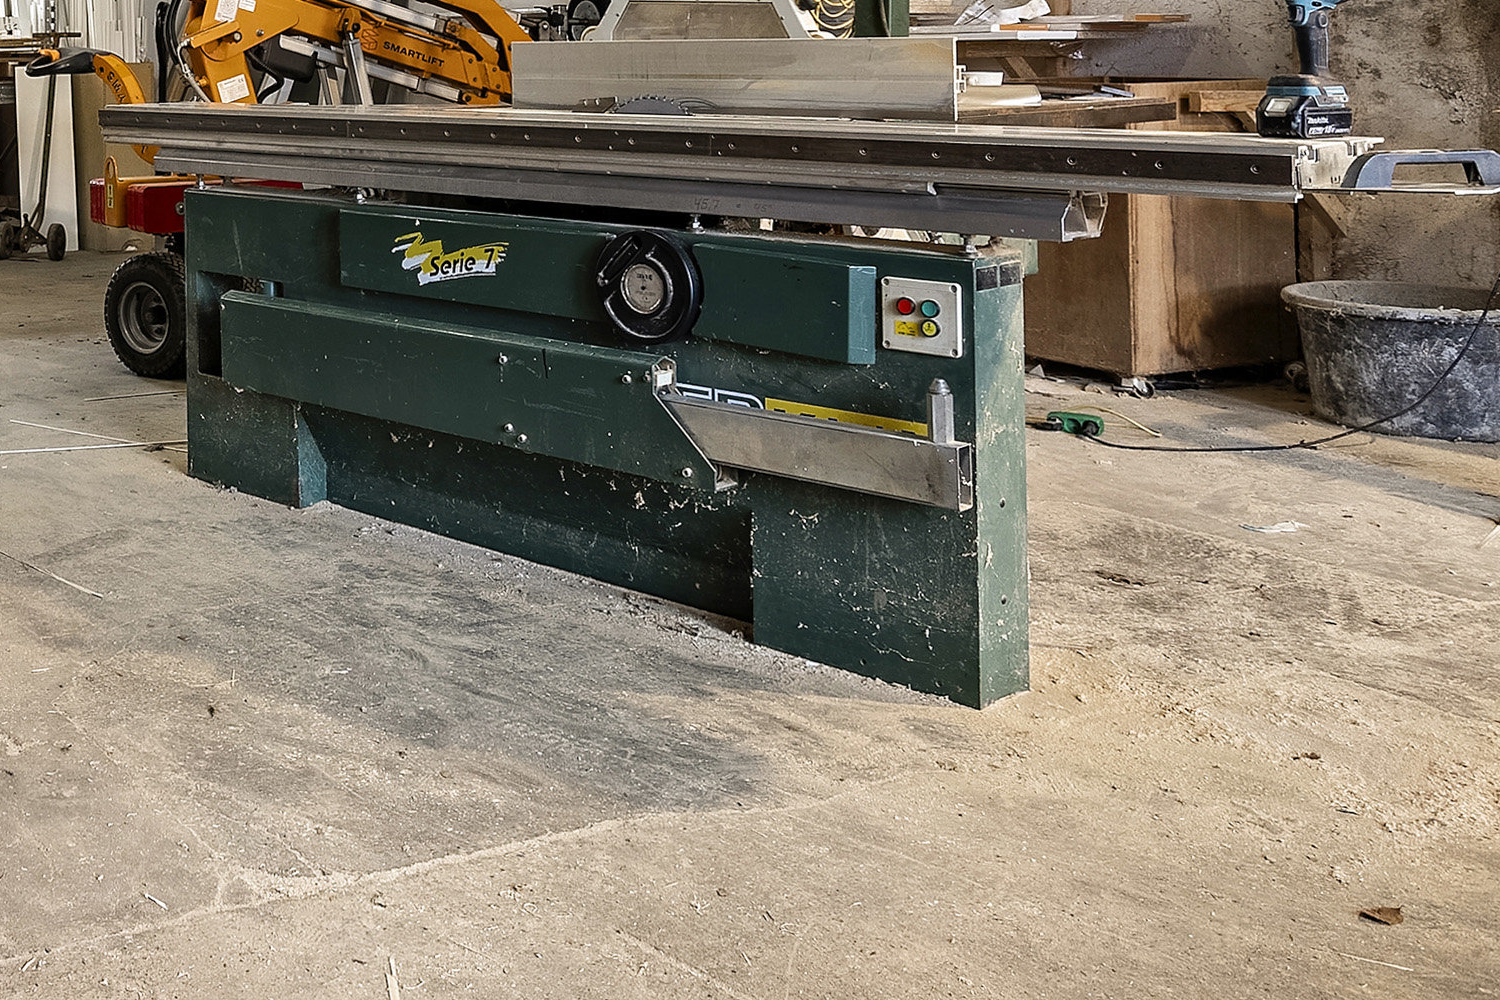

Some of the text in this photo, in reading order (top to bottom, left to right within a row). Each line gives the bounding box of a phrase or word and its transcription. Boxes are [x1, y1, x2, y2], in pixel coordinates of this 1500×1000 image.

[382, 40, 445, 67] SMARTLIFT
[429, 248, 495, 277] Serie 7
